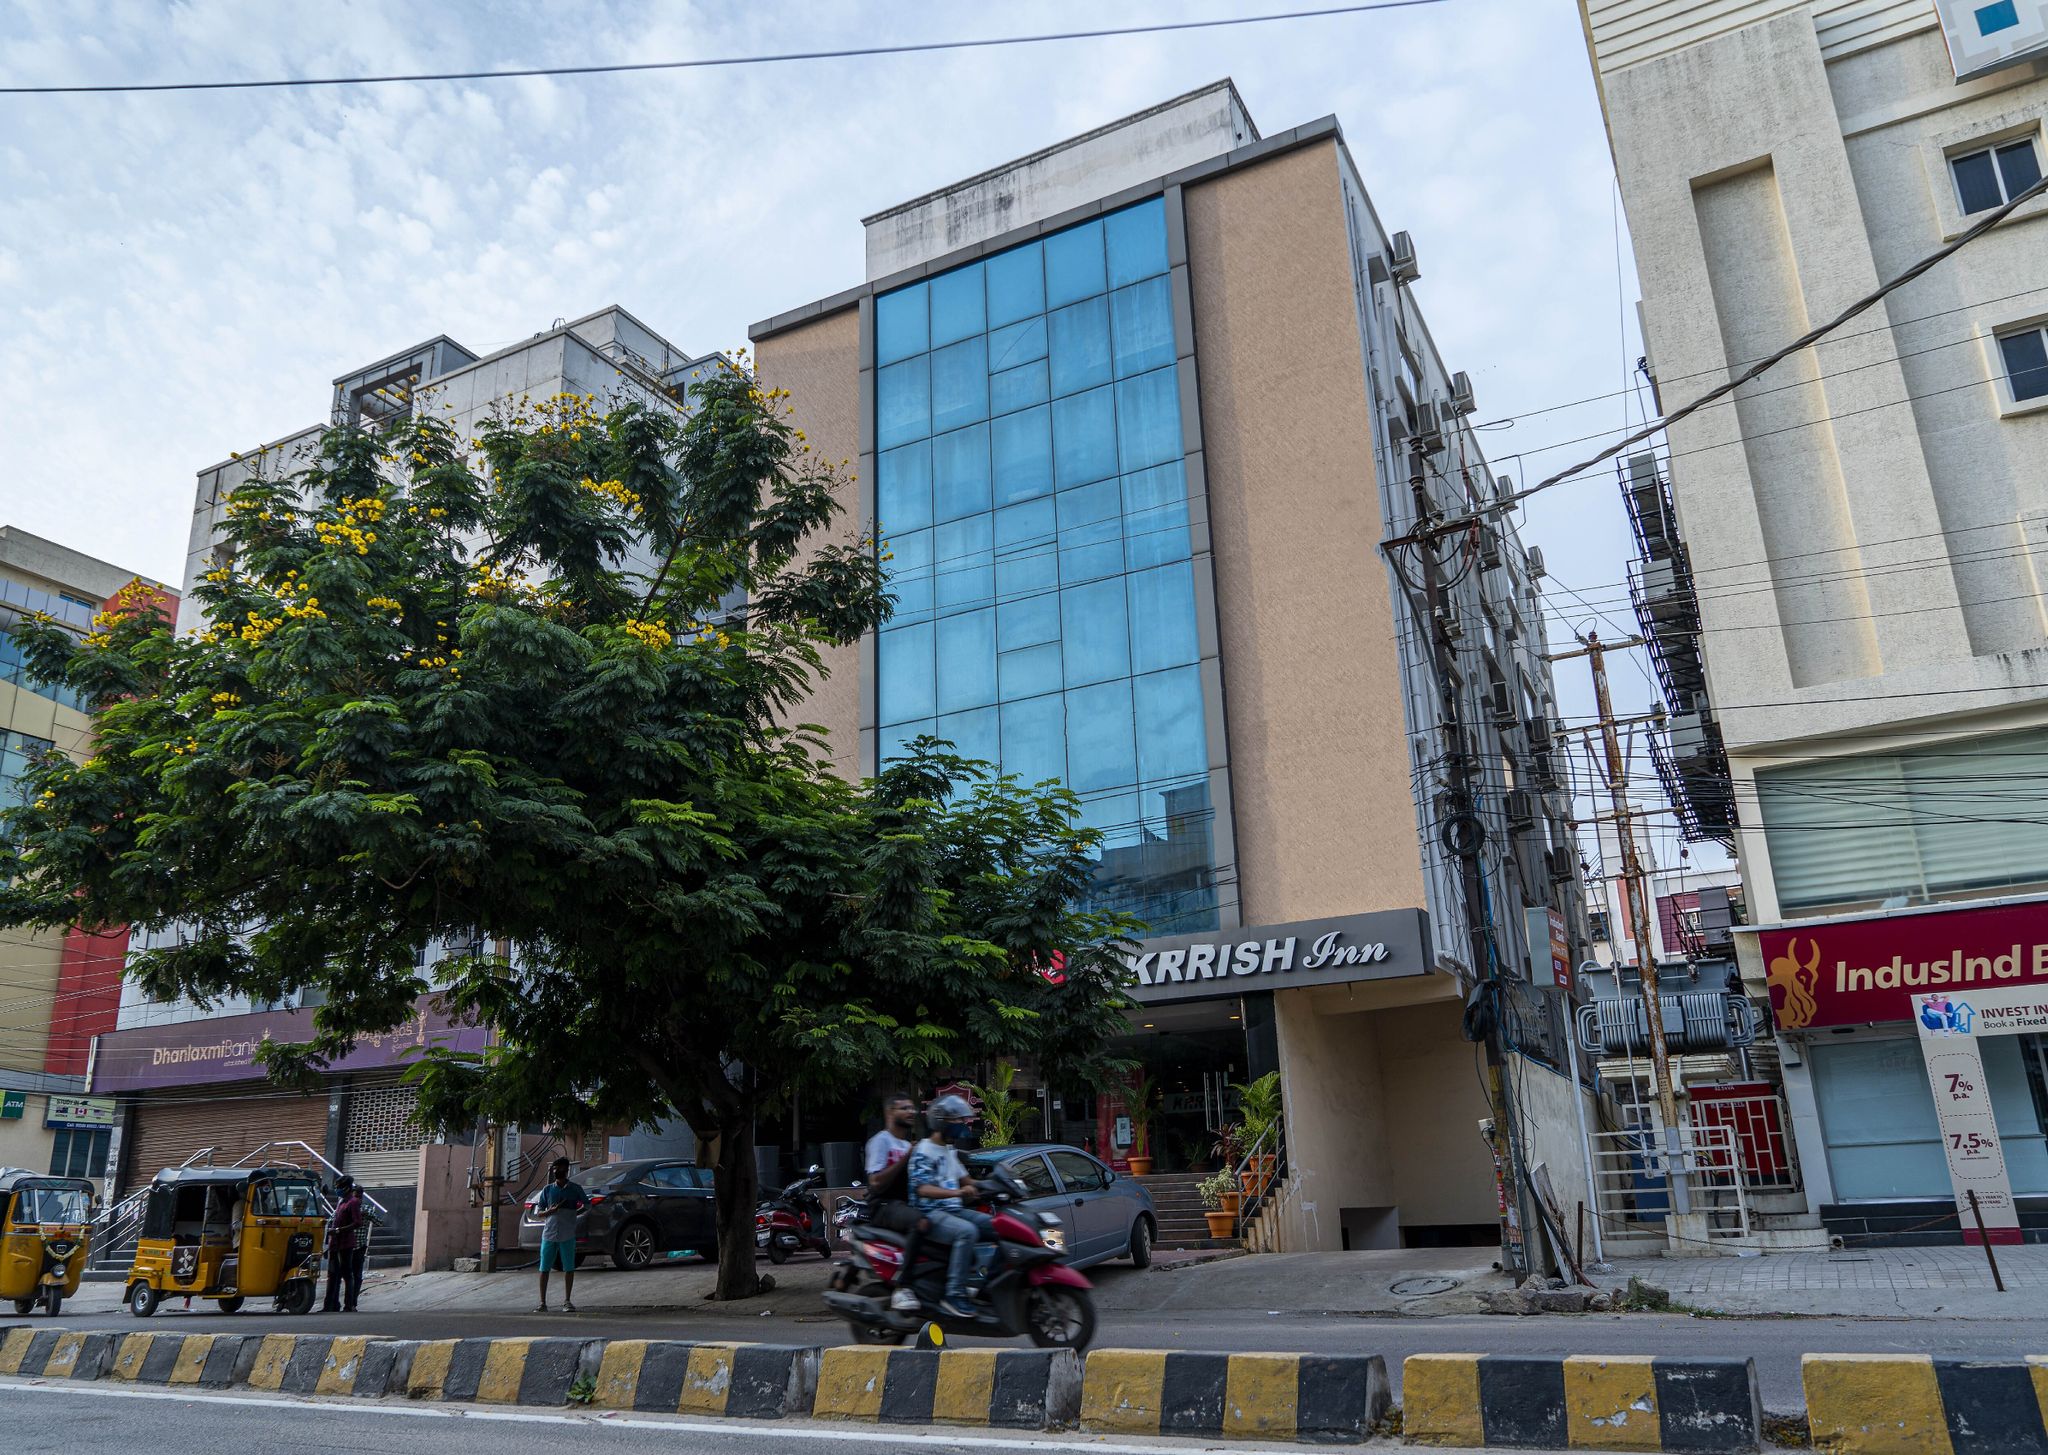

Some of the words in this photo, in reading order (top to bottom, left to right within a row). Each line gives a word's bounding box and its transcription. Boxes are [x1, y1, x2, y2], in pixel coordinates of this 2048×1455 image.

[1125, 937, 1297, 986] KRRISH
[1303, 931, 1389, 968] Inn
[1836, 944, 2022, 992] IndusInd
[1981, 1005, 2030, 1019] INVEST
[1984, 1020, 2006, 1029] Book
[2017, 1017, 2047, 1027] Fixed
[1953, 1093, 1970, 1101] p.a.
[4, 1100, 24, 1108] ATM
